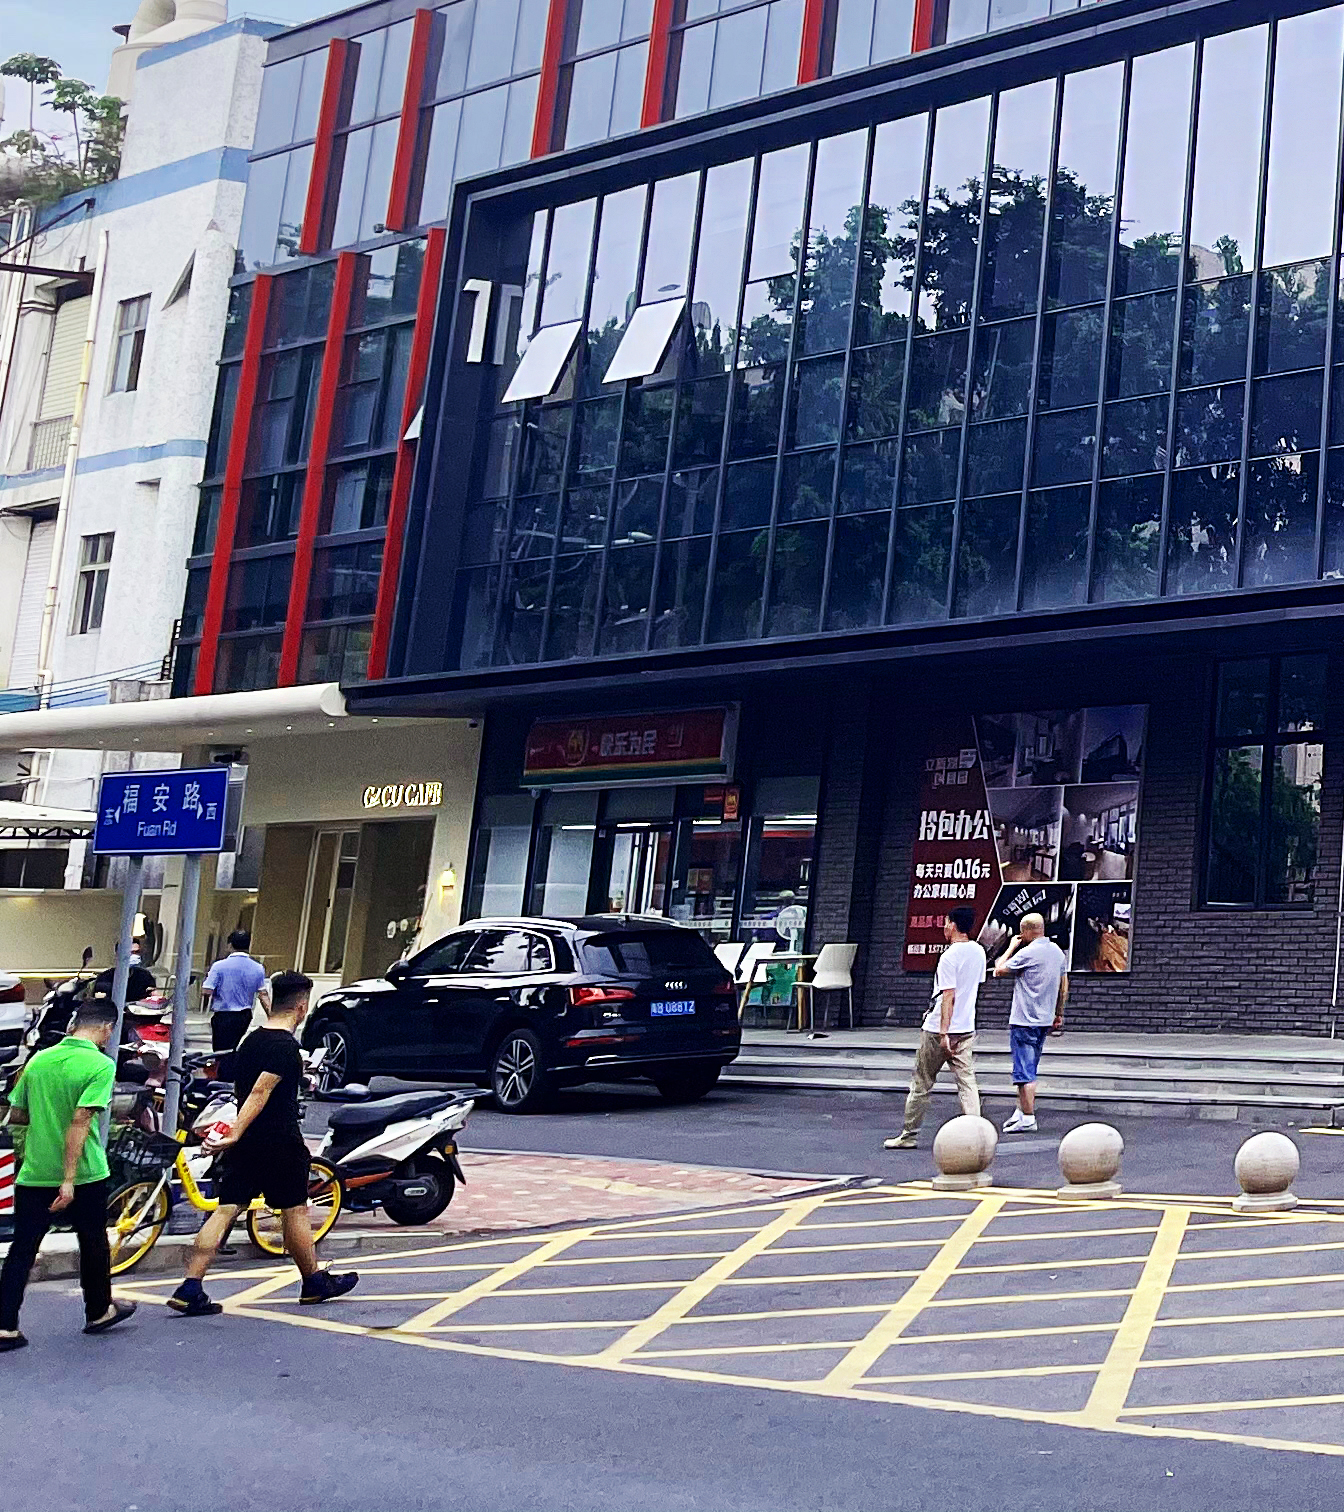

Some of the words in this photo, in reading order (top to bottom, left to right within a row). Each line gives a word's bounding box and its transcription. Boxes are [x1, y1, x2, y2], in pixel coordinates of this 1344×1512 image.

[122, 781, 200, 814] 福安路
[136, 821, 162, 837] Fuan
[162, 820, 178, 837] Rd
[918, 809, 990, 841] 拎包办公
